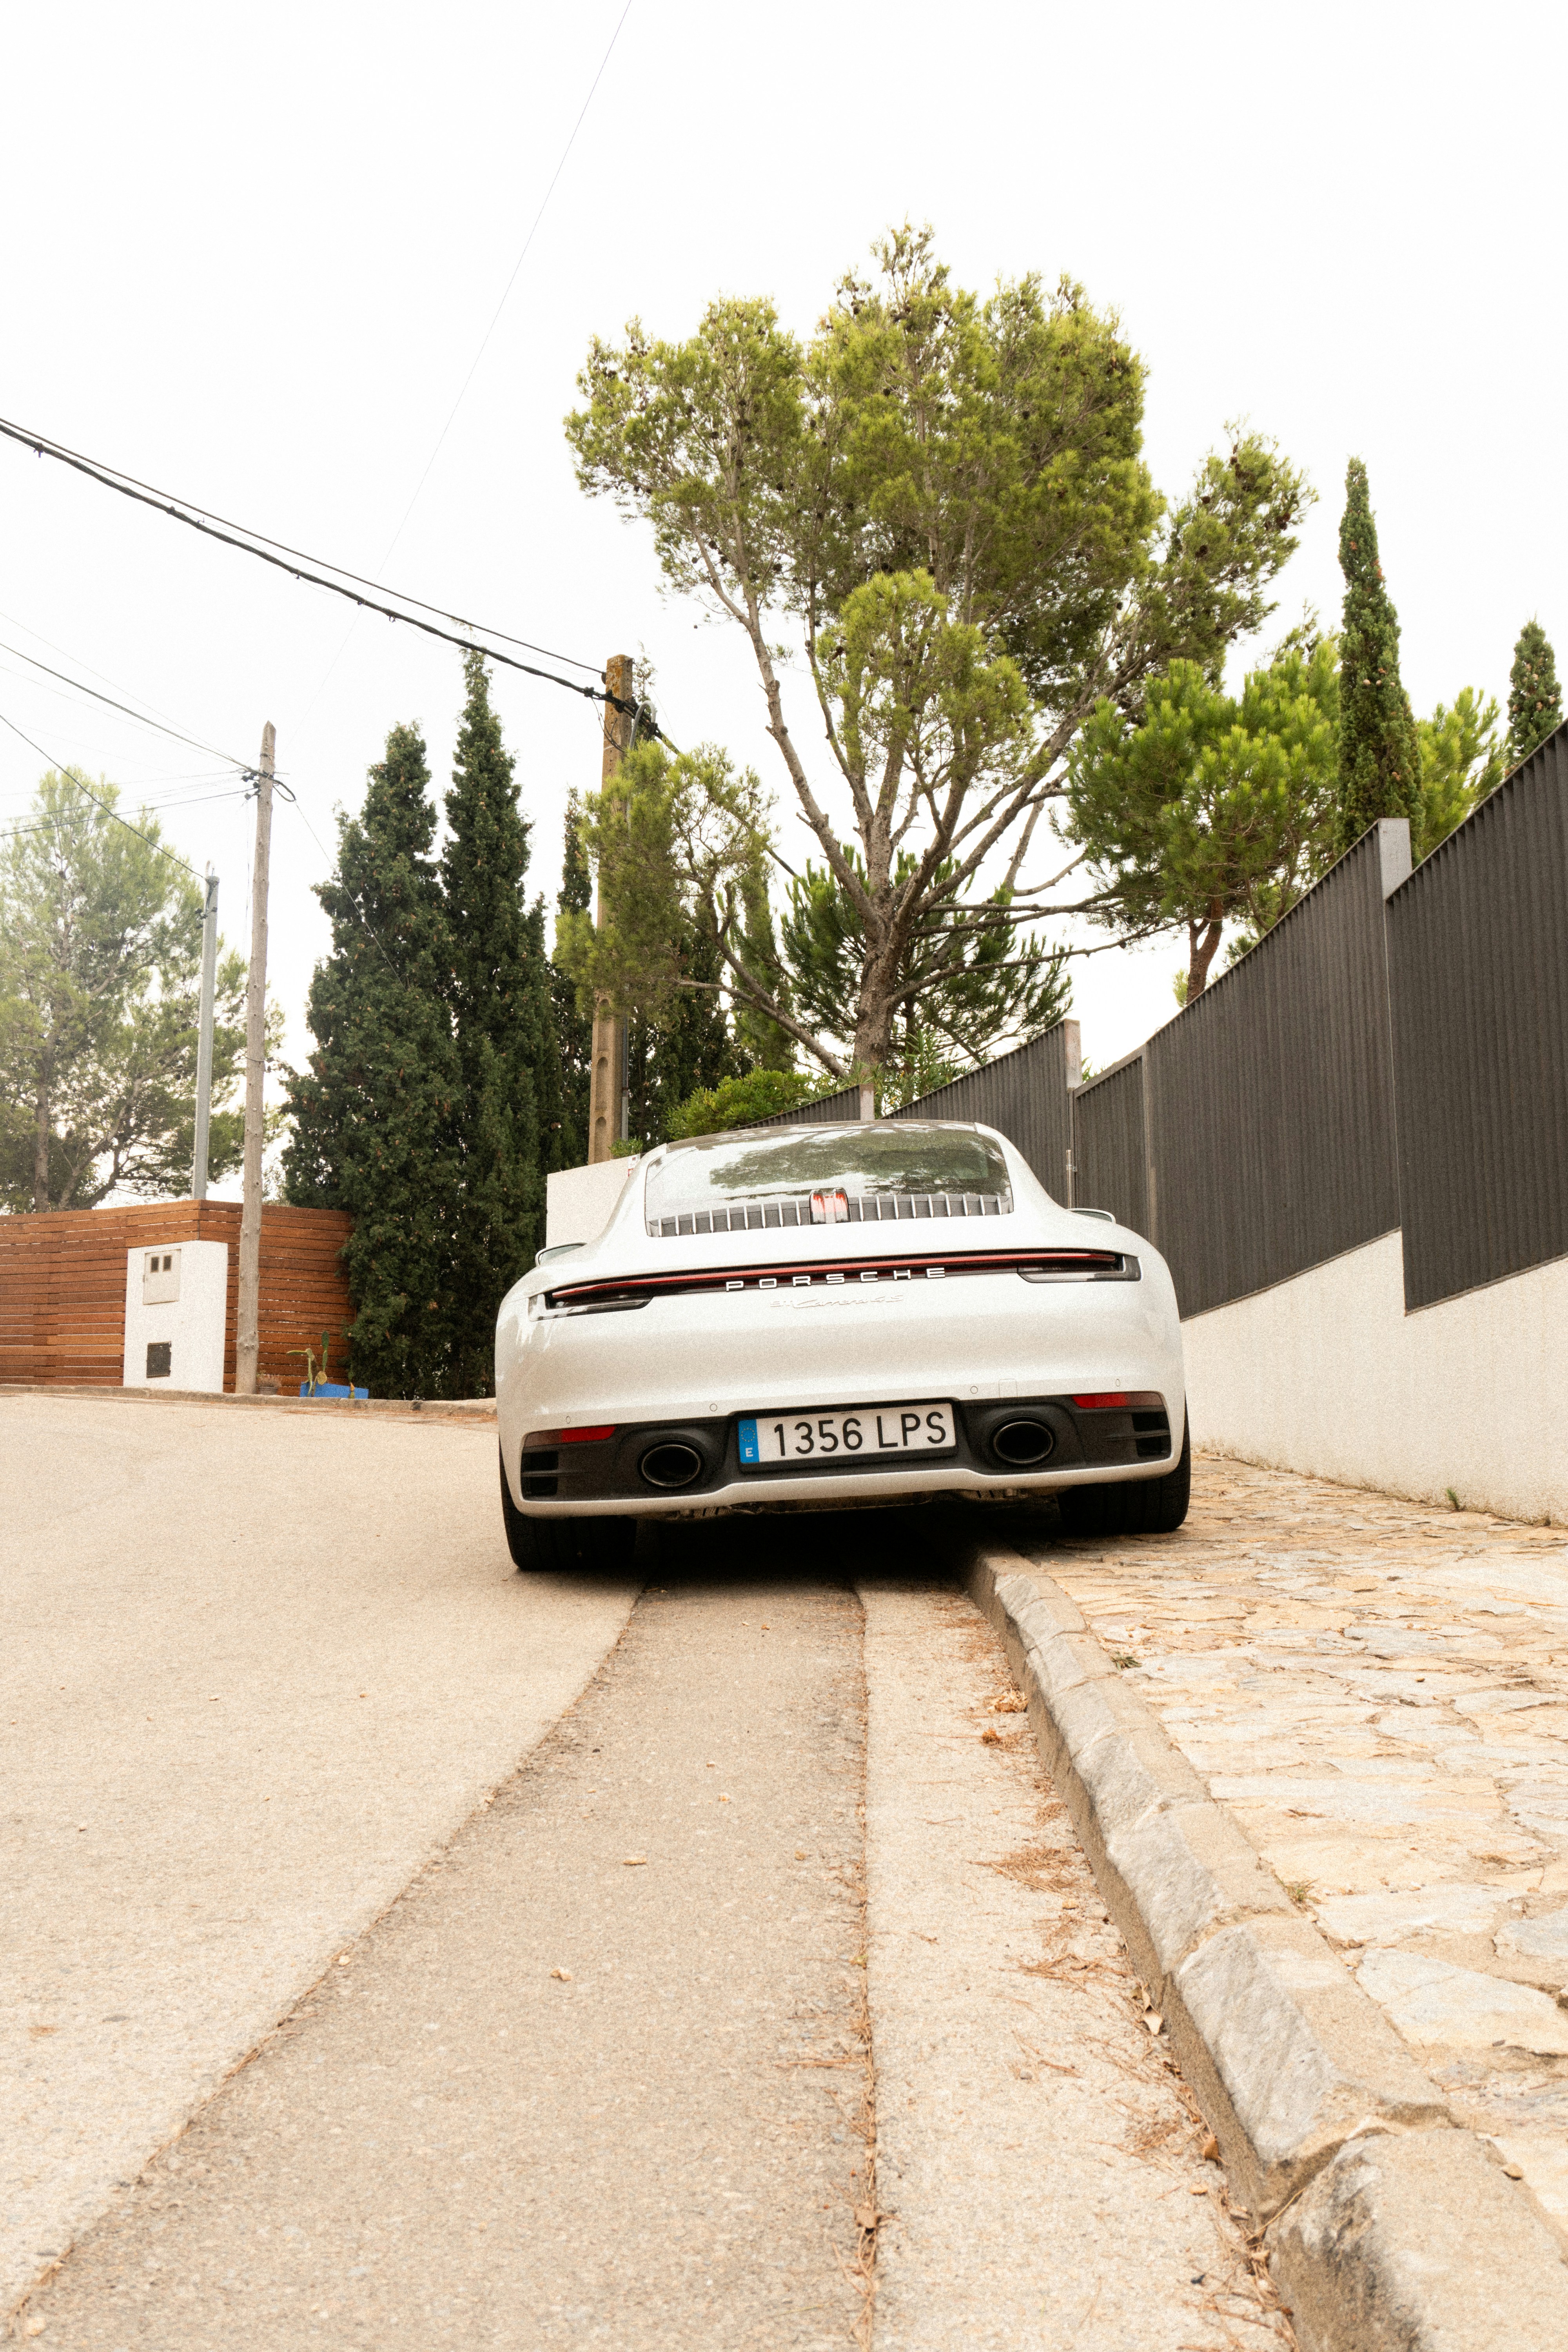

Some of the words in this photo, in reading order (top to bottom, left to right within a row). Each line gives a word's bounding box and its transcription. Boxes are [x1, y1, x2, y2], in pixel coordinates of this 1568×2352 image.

[726, 1268, 945, 1291] PORSCHE
[791, 1295, 869, 1308] Carrera
[774, 1418, 862, 1456] 1356
[876, 1412, 946, 1448] LPS
[746, 1447, 753, 1457] E
